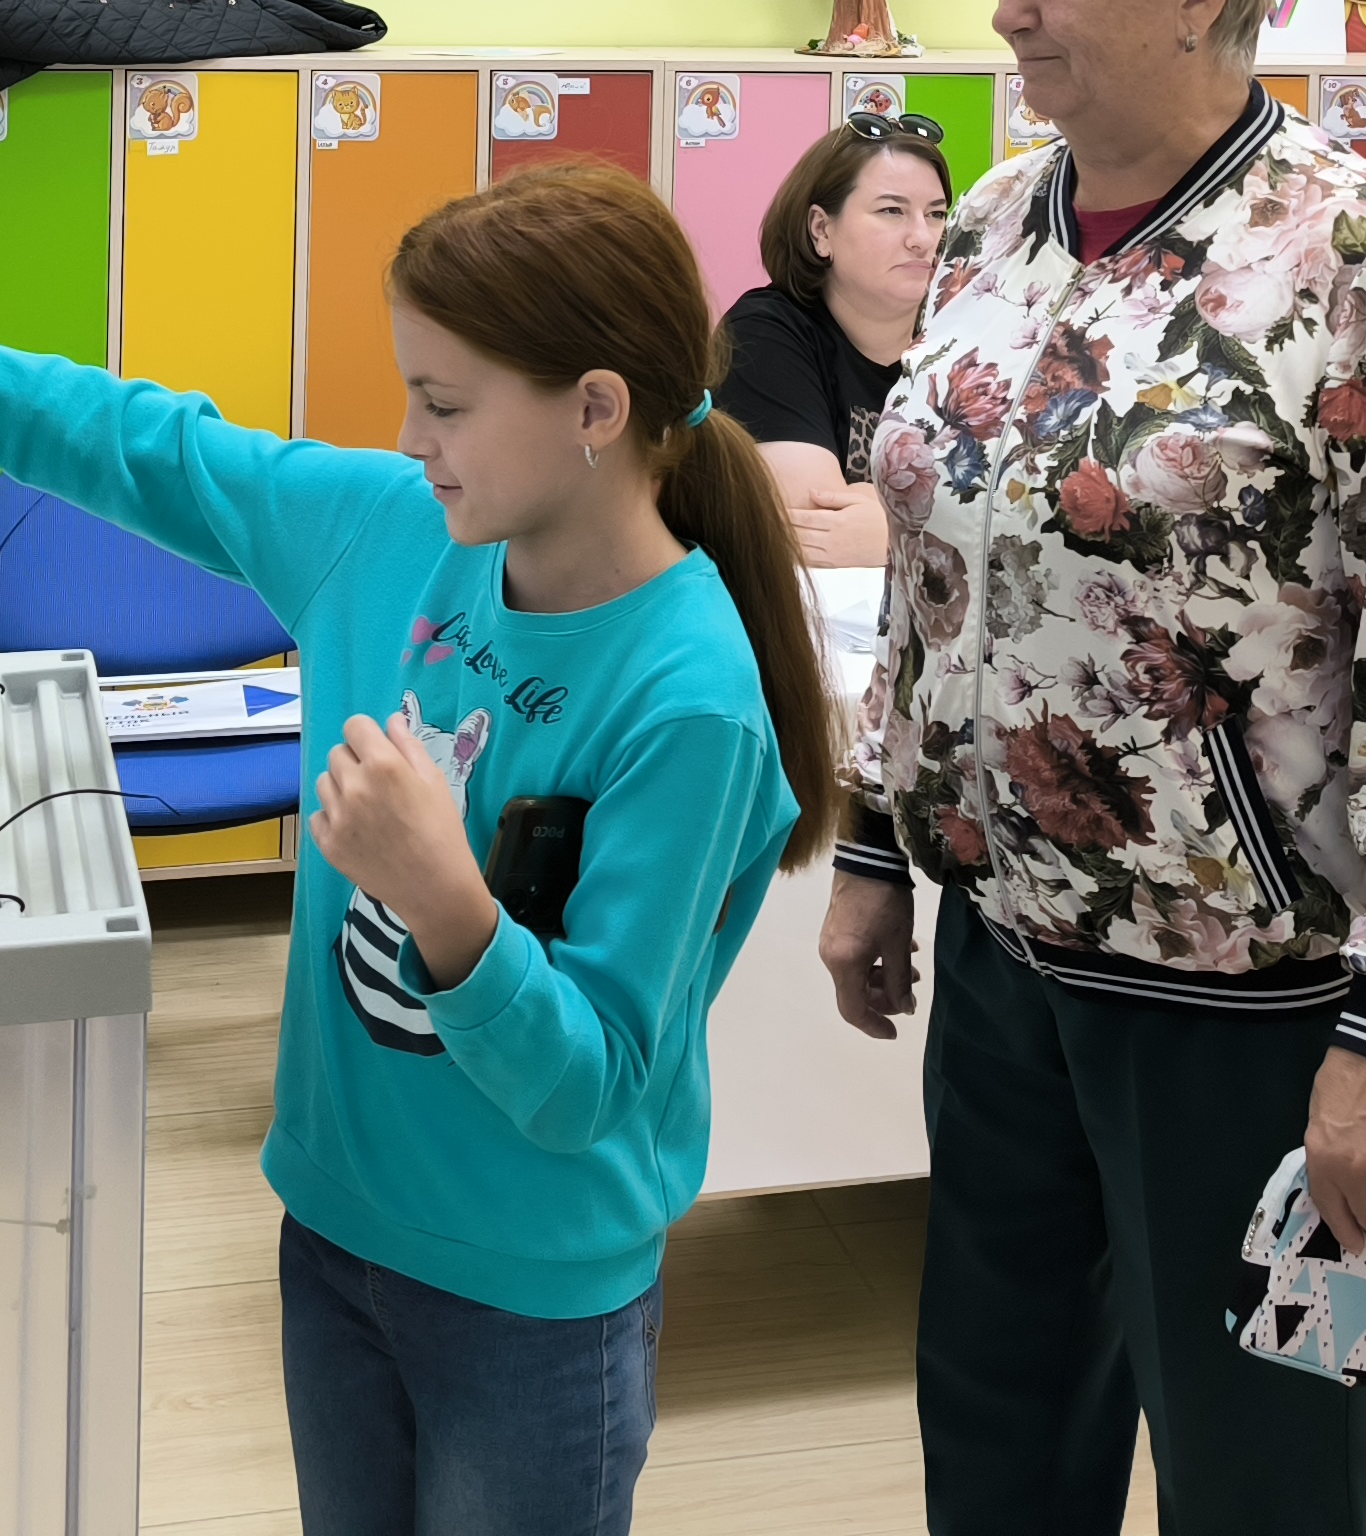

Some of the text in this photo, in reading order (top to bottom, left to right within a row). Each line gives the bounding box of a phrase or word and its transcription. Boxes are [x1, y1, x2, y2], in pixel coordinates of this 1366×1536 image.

[136, 78, 143, 86] 3
[321, 78, 329, 86] 4
[685, 79, 692, 87] 6
[852, 80, 860, 88] 7
[464, 640, 509, 688] Love
[503, 676, 569, 724] Life
